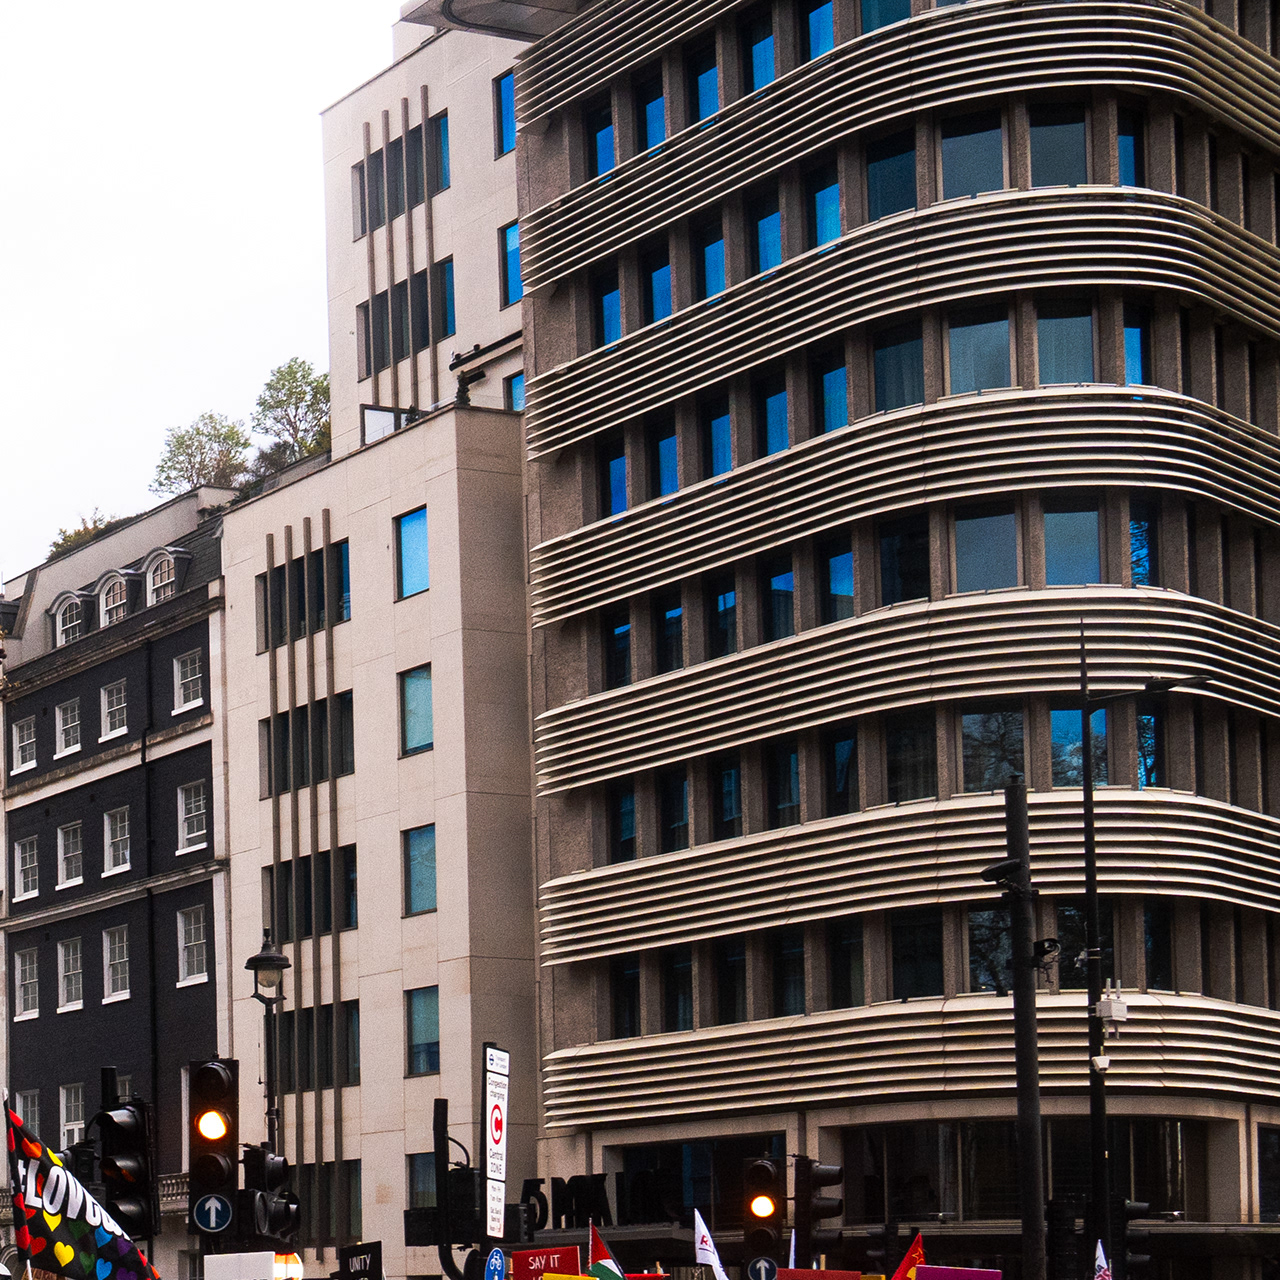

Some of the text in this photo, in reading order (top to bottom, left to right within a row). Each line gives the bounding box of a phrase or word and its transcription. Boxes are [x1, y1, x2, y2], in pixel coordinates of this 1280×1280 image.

[349, 1253, 372, 1273] UNITY
[528, 1254, 561, 1270] SAY IT
